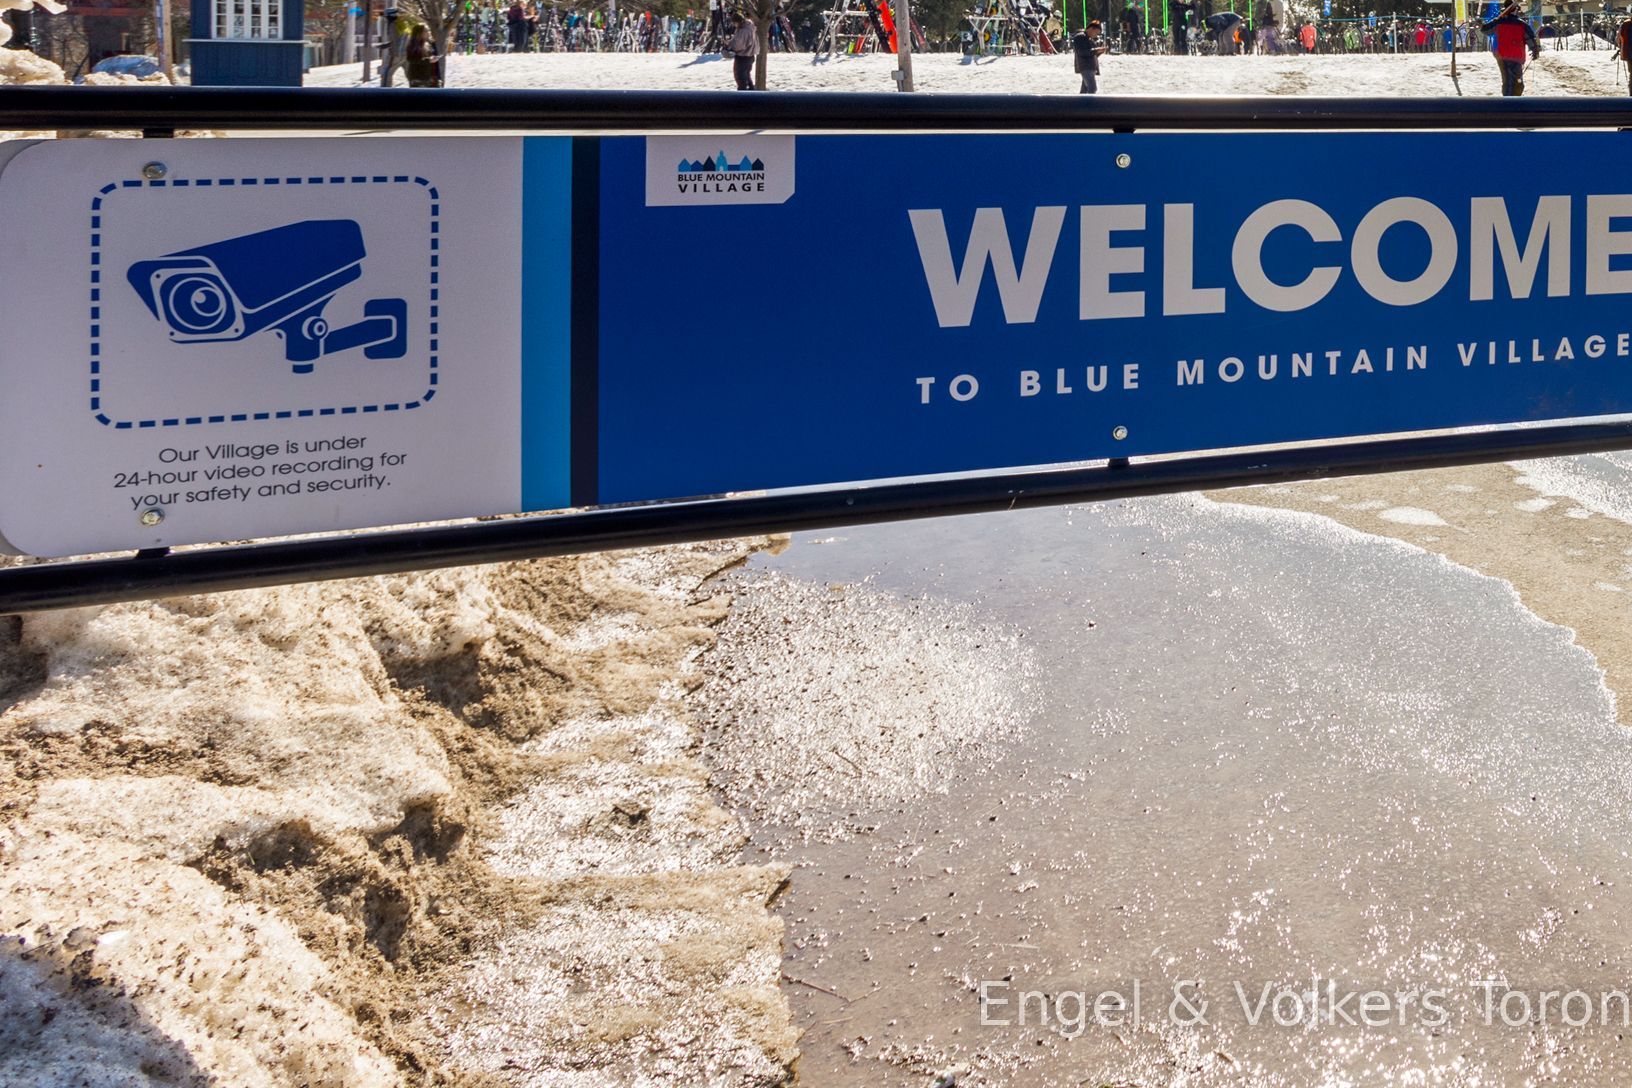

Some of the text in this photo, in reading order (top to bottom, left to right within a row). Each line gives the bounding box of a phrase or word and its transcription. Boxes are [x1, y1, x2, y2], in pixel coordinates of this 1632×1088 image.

[678, 172, 765, 181] BLUE MOUNTAIN
[678, 183, 765, 193] VILLAGE
[916, 333, 1631, 405] TO BLUE MOUNTAIN VILLAGE
[159, 435, 367, 463] Our Village is under
[113, 451, 407, 488] 24-hour video recording for
[131, 473, 391, 511] your safety and security.
